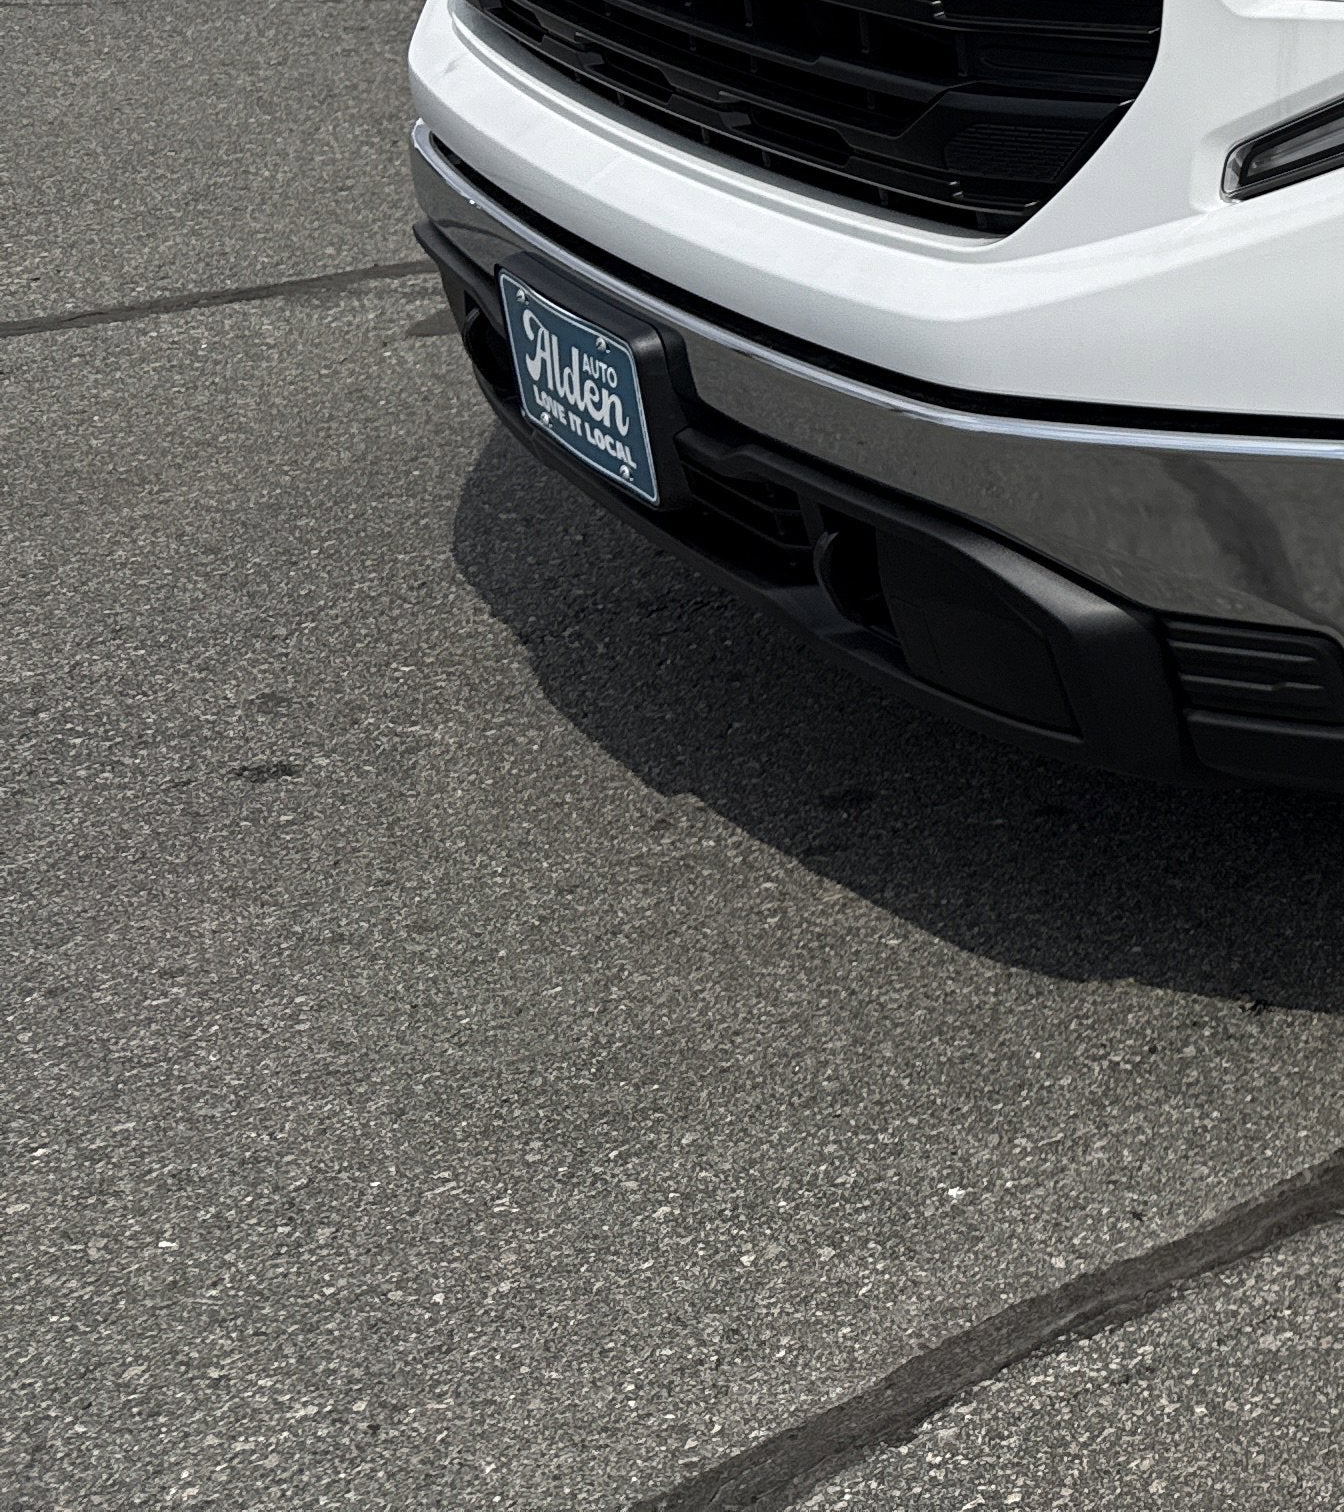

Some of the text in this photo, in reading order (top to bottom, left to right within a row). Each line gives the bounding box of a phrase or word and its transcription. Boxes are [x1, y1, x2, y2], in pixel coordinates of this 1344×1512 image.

[523, 309, 629, 437] Alden
[582, 353, 617, 388] AUTO
[533, 384, 637, 469] LOVE IT LOCAL
